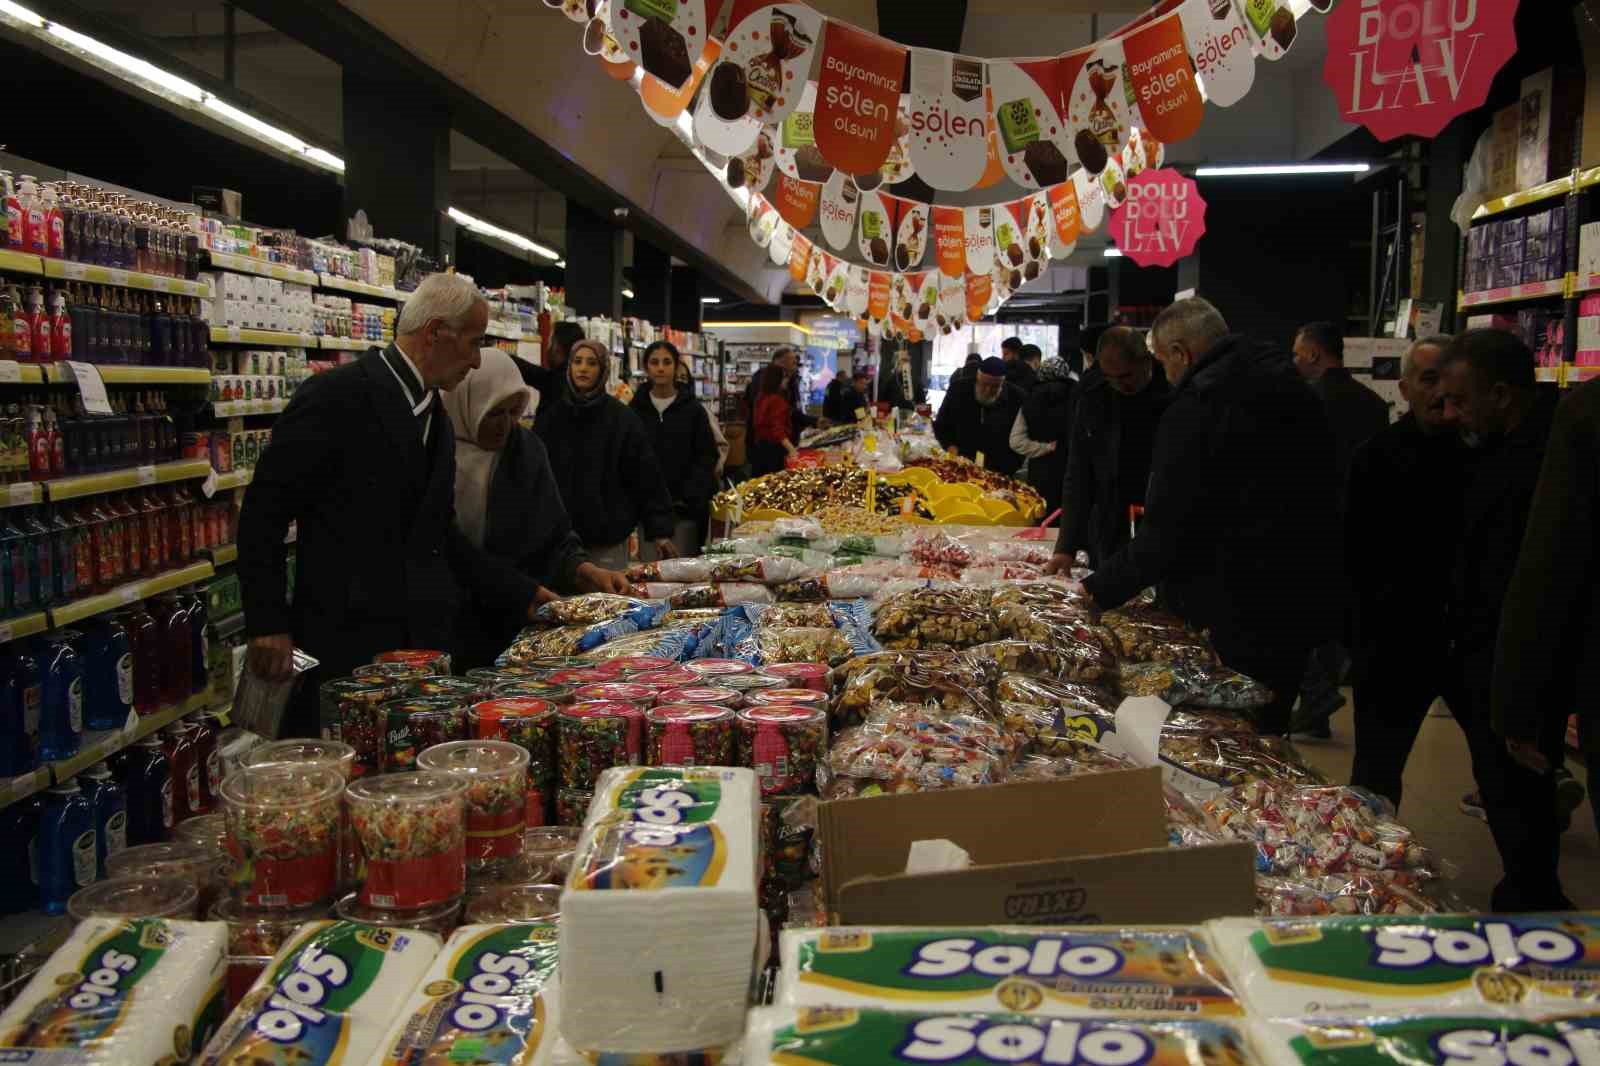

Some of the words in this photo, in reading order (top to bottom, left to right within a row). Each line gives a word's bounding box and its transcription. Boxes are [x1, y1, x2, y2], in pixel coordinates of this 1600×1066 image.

[1346, 33, 1486, 115] LAV
[825, 85, 889, 122] şölen
[911, 106, 985, 138] şölen
[834, 117, 878, 142] olsun!
[1127, 183, 1188, 200] DOLU
[1127, 201, 1187, 219] DOLU
[1121, 220, 1190, 252] LAV
[908, 938, 1120, 977] Solo
[1375, 922, 1578, 968] Solo
[69, 948, 138, 1009] Solo
[256, 946, 348, 1042] Solo
[453, 951, 532, 1030] Solo
[901, 1016, 1149, 1066] Solo
